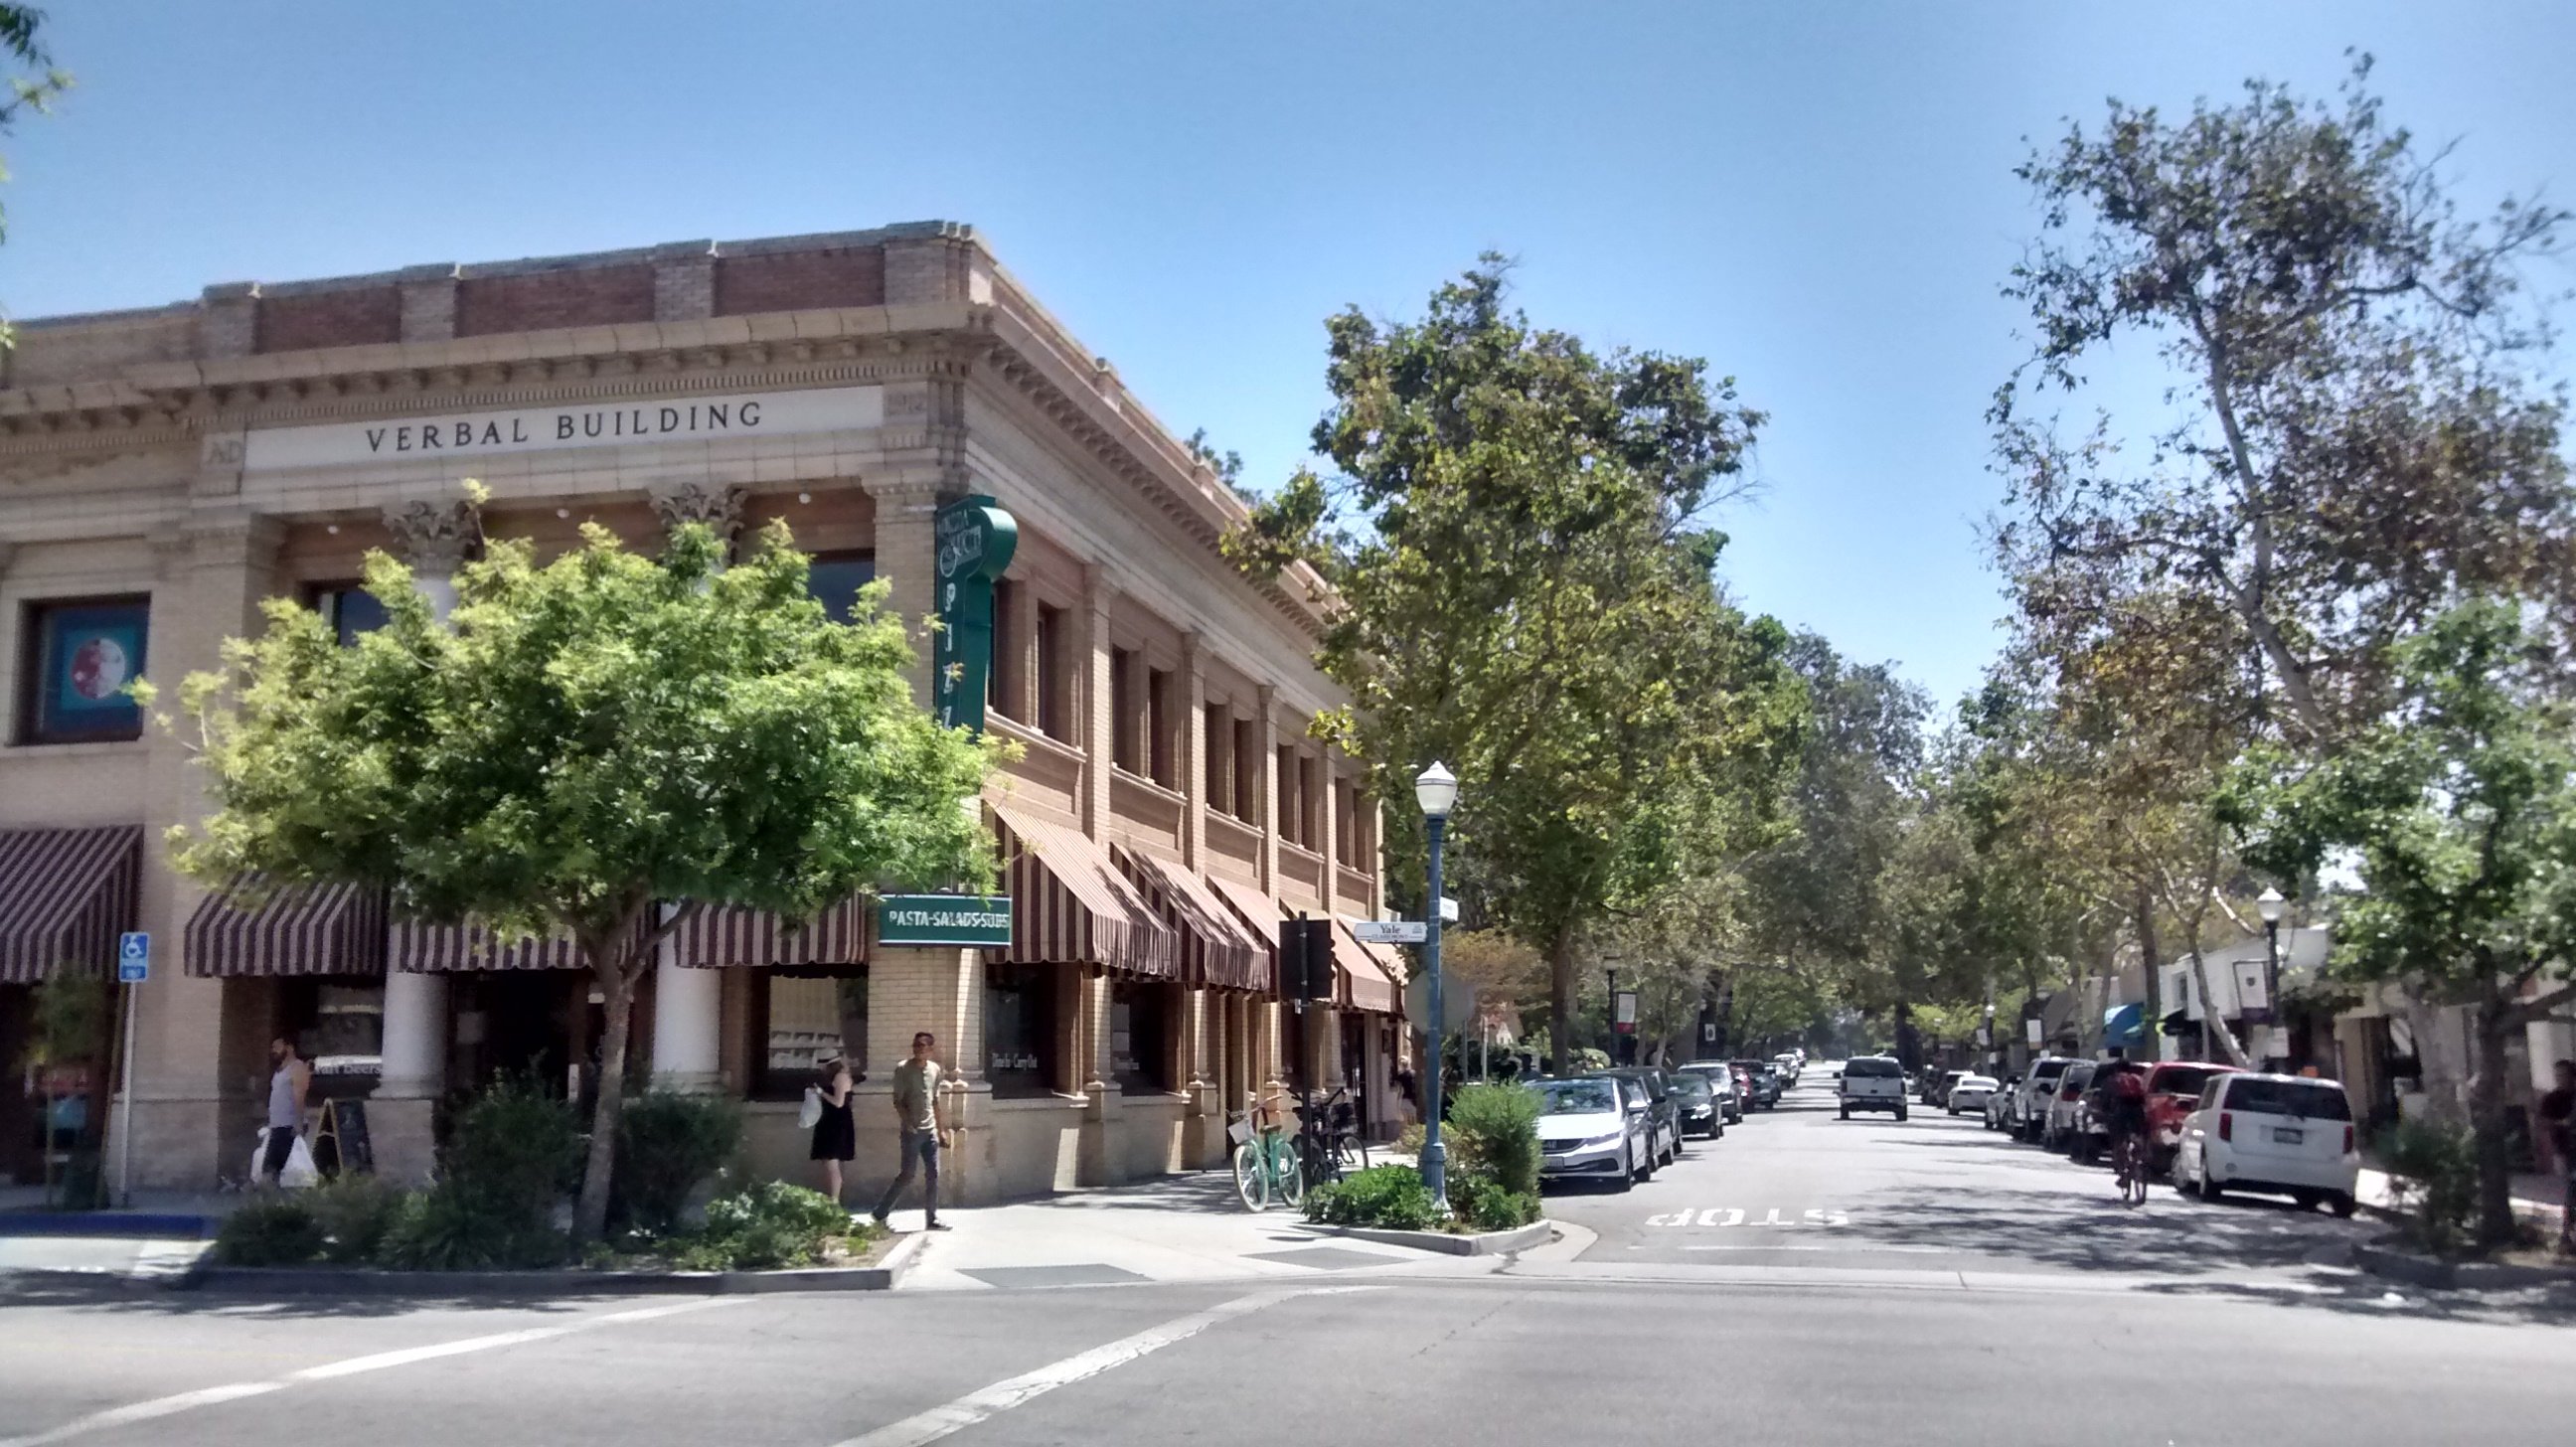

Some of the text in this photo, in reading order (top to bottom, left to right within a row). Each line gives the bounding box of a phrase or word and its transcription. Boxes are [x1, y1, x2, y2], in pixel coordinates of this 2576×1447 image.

[365, 402, 761, 452] VERBAL BUILDING
[1379, 924, 1401, 934] Yale
[1645, 1207, 1849, 1226] STOP
